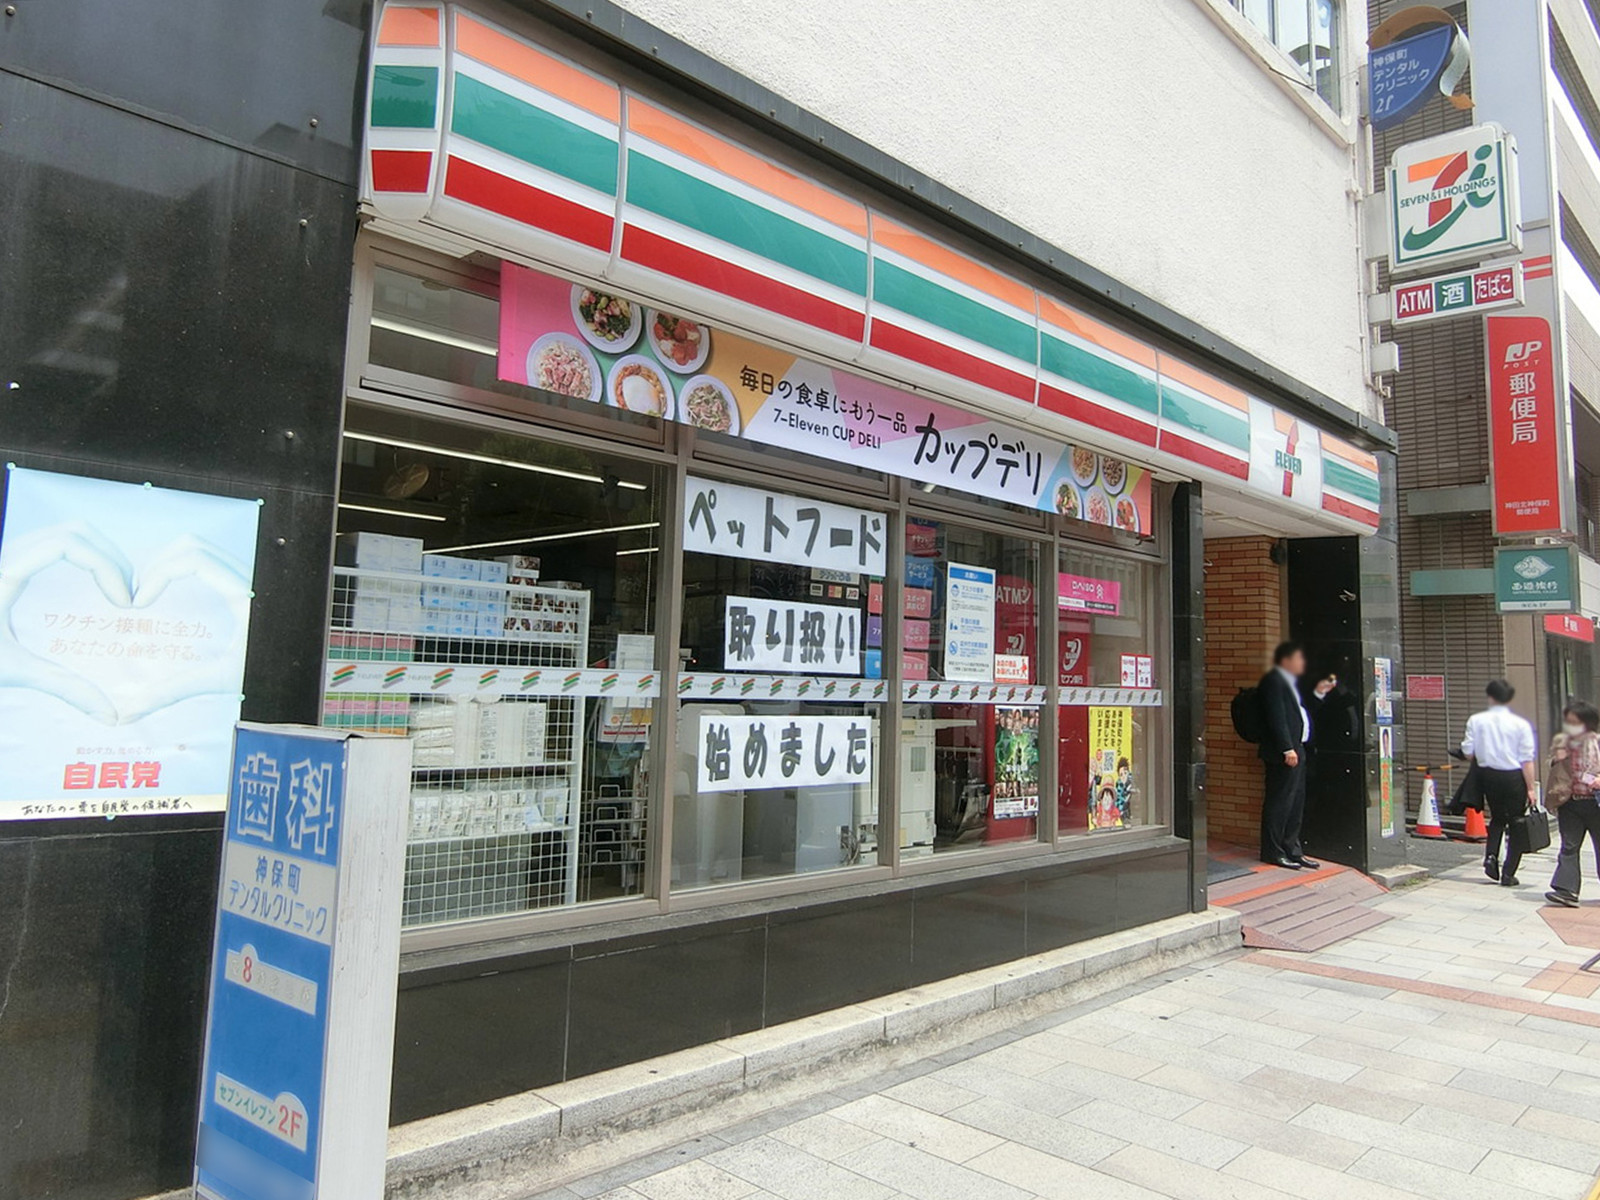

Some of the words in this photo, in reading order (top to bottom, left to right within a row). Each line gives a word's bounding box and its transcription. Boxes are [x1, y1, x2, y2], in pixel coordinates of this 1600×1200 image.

[1373, 48, 1407, 68] 神保町
[1374, 68, 1430, 95] クリニック
[1444, 176, 1496, 198] HOLDINGS
[1399, 289, 1431, 314] ATM
[1442, 282, 1465, 307] 酒
[1476, 275, 1512, 300] たばこ
[1503, 359, 1539, 370] POST
[740, 364, 908, 435] 毎日の食卓にもう一品
[1509, 371, 1538, 444] 郵便局
[774, 408, 830, 437] 7-Eleven
[832, 425, 855, 443] CUP
[858, 431, 881, 450] DELI
[914, 412, 1042, 496] カップデリ
[689, 488, 882, 567] ペットフード
[996, 585, 1021, 605] ATM
[44, 613, 213, 640] ワクチン接種に全力。
[729, 605, 855, 664] 取り扱い
[705, 722, 867, 783] 始めました
[63, 761, 162, 790] 自民党
[236, 752, 335, 856] 歯科
[255, 855, 302, 895] 神保町
[242, 956, 253, 983] 8
[220, 1083, 276, 1126] セブンイレブン
[278, 1104, 303, 1139] 2F
